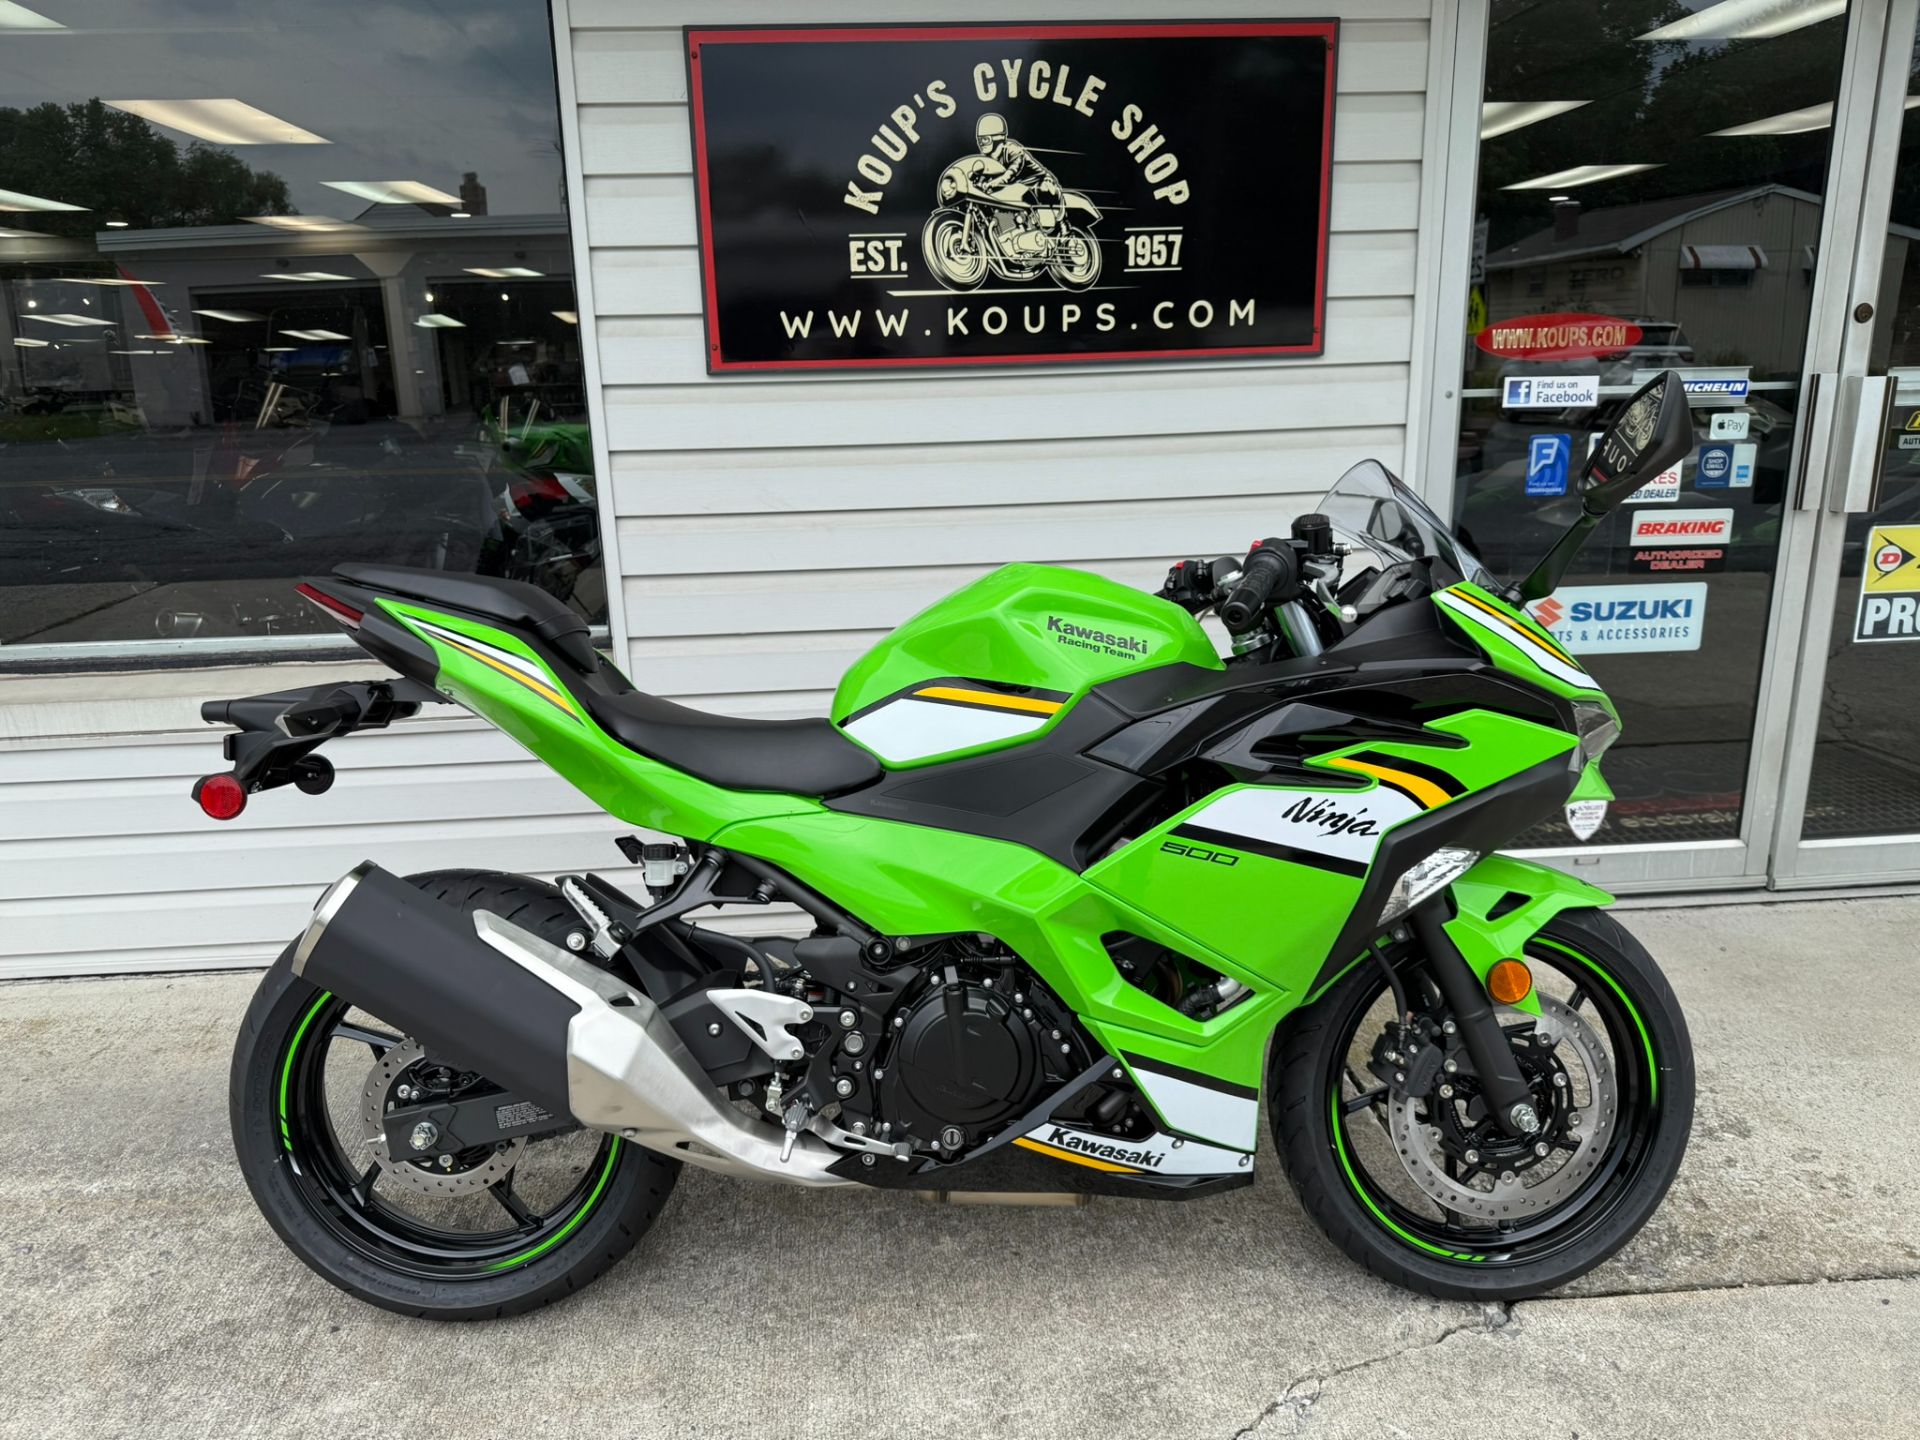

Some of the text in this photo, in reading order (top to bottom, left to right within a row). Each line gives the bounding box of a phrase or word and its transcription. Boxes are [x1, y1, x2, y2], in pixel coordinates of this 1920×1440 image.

[843, 58, 1190, 215] KOUP'S CYCLE SHOP
[849, 240, 908, 272] EST.
[1124, 234, 1183, 267] 1957
[780, 299, 1256, 339] WWW.KOUPS.COM
[1491, 325, 1627, 350] WWW.KOUPS.COM
[1536, 390, 1593, 403] Facebook
[1537, 381, 1554, 389] Find
[1727, 420, 1745, 433] Pay
[1903, 437, 1920, 446] AUT
[1643, 488, 1678, 499] DEALER
[1637, 520, 1725, 535] BRAKING
[1634, 549, 1723, 561] AUTHORIZED
[1650, 560, 1705, 570] DEALER
[1570, 598, 1693, 622] SUZUKI
[1047, 615, 1148, 655] Kawasaki
[1580, 630, 1589, 641] &
[1597, 626, 1690, 641] ACCESSORIES
[1057, 634, 1136, 661] Racing Team
[1281, 797, 1380, 838] Ninja
[1160, 841, 1240, 867] 500
[1048, 1127, 1167, 1168] Kawasaki
